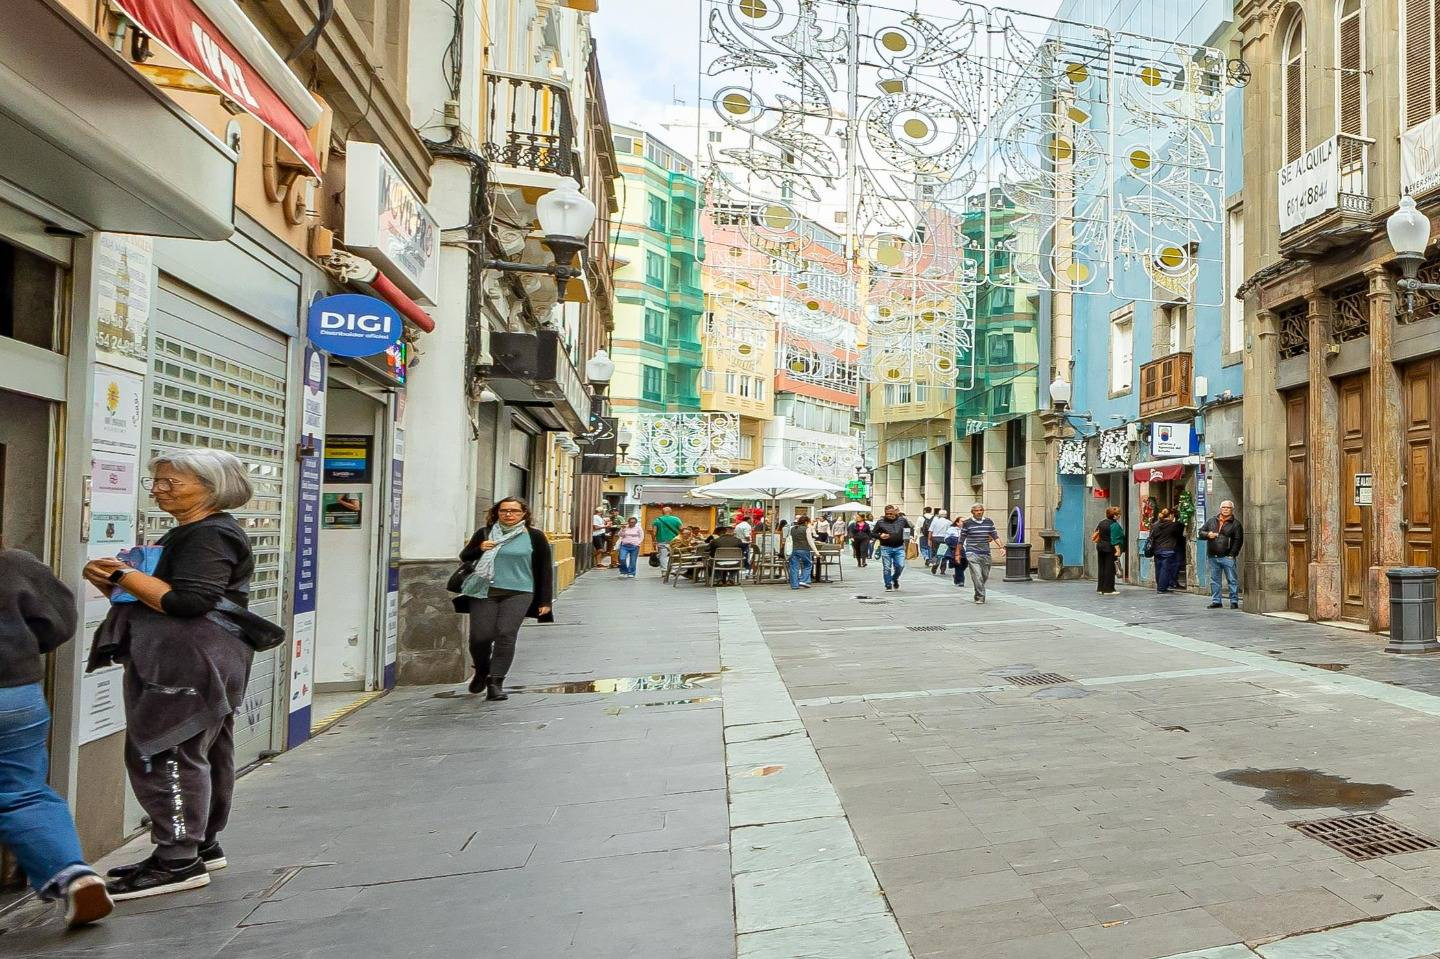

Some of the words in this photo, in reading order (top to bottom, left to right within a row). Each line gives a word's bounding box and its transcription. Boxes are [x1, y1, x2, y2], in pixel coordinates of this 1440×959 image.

[1281, 165, 1292, 186] SE
[1295, 141, 1333, 179] ALQUILA
[321, 311, 391, 333] DIGI
